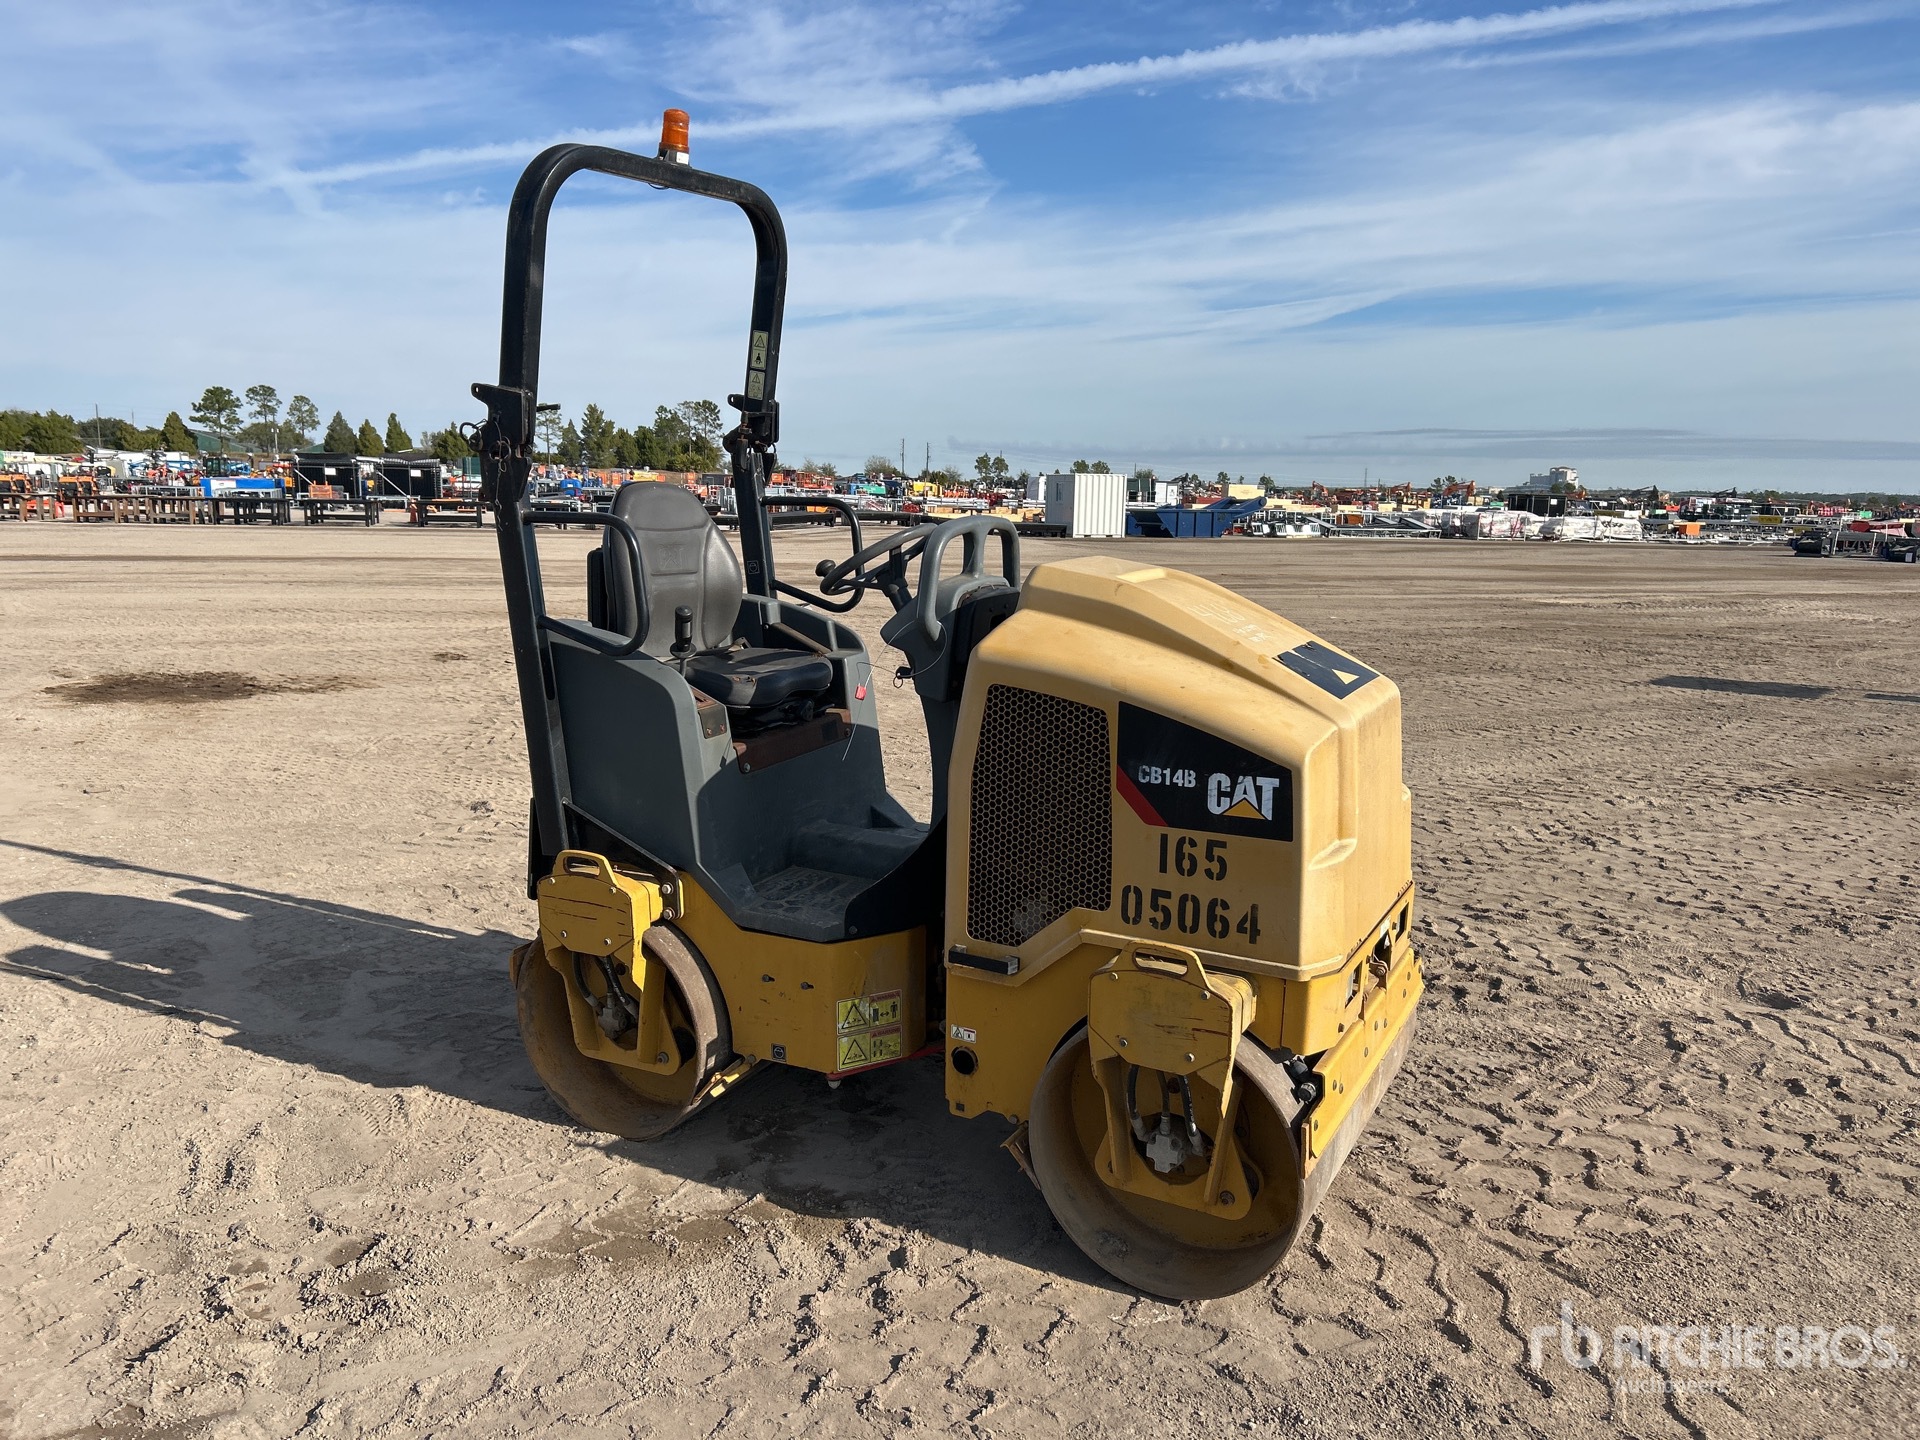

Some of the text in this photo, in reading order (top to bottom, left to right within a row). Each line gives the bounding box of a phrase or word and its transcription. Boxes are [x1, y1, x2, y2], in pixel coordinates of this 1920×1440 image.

[1138, 765, 1197, 788] CB14B
[1207, 772, 1280, 821] CAT
[1121, 884, 1261, 945] 05064
